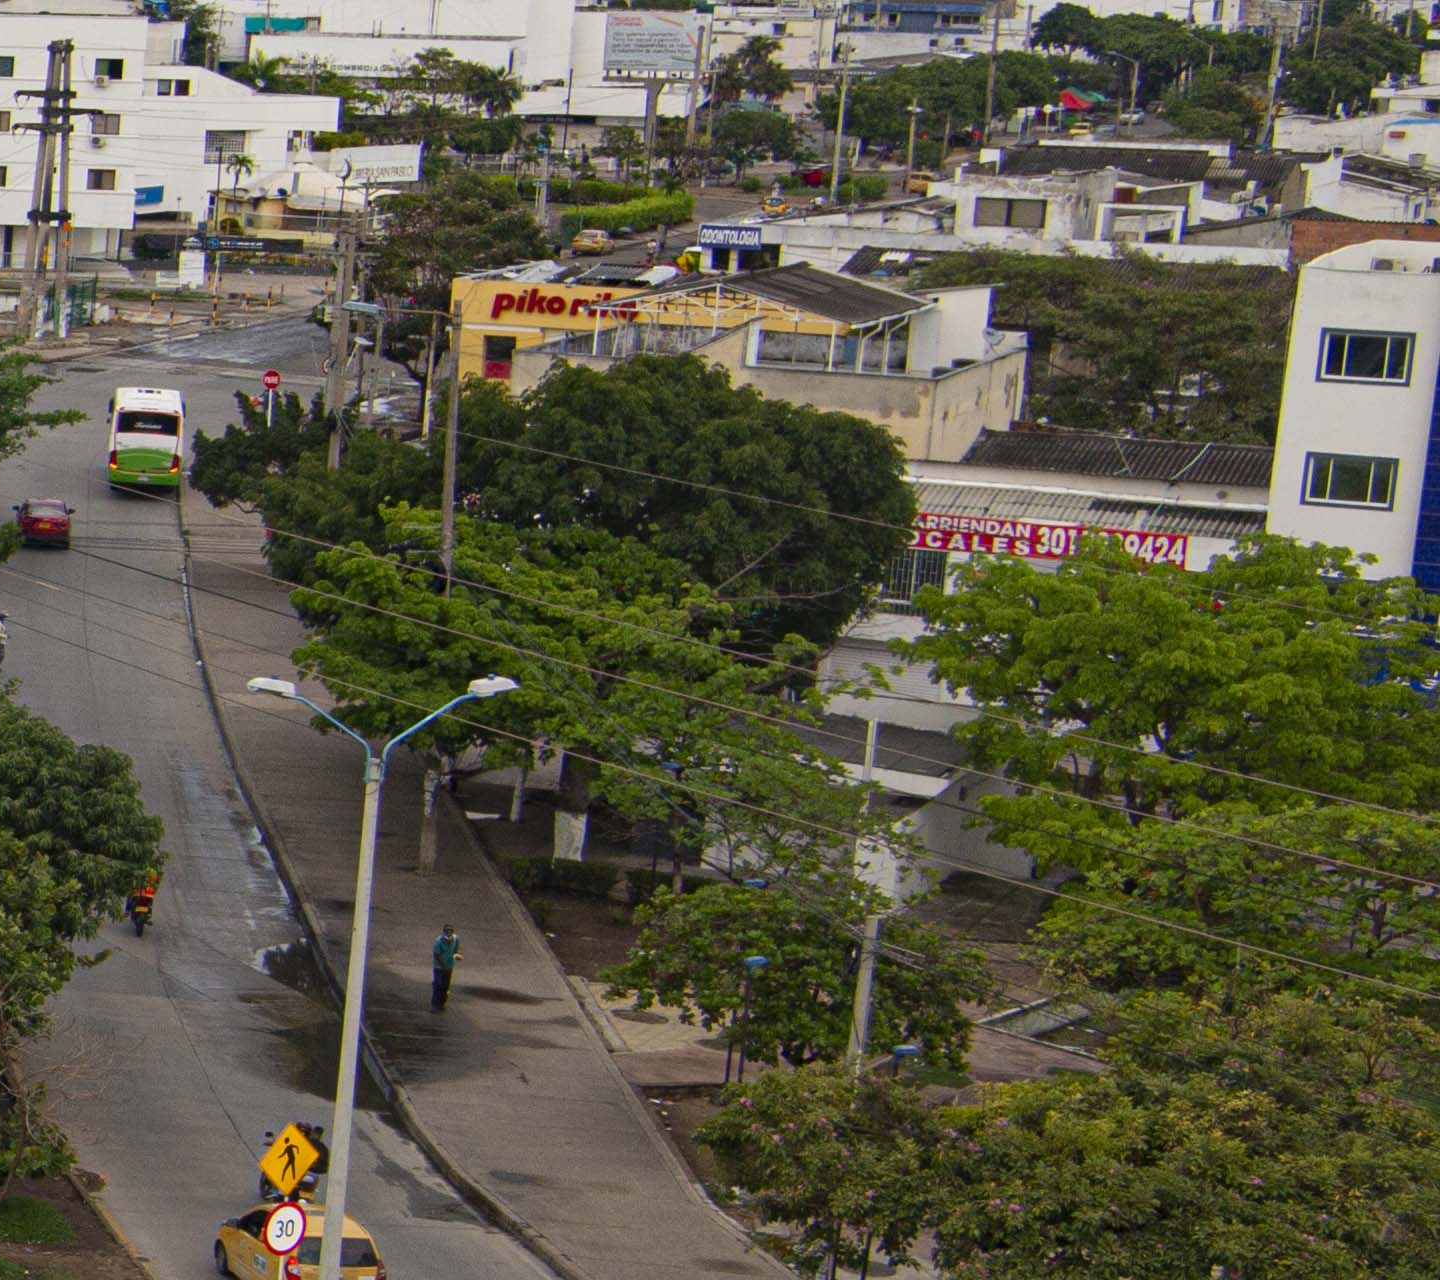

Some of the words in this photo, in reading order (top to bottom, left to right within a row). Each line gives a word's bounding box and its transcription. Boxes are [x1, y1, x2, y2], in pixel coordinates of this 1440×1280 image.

[700, 228, 761, 246] ODONTOLOGIA
[492, 288, 566, 319] piko
[910, 532, 1030, 556] OCALES
[275, 1220, 295, 1238] 30
